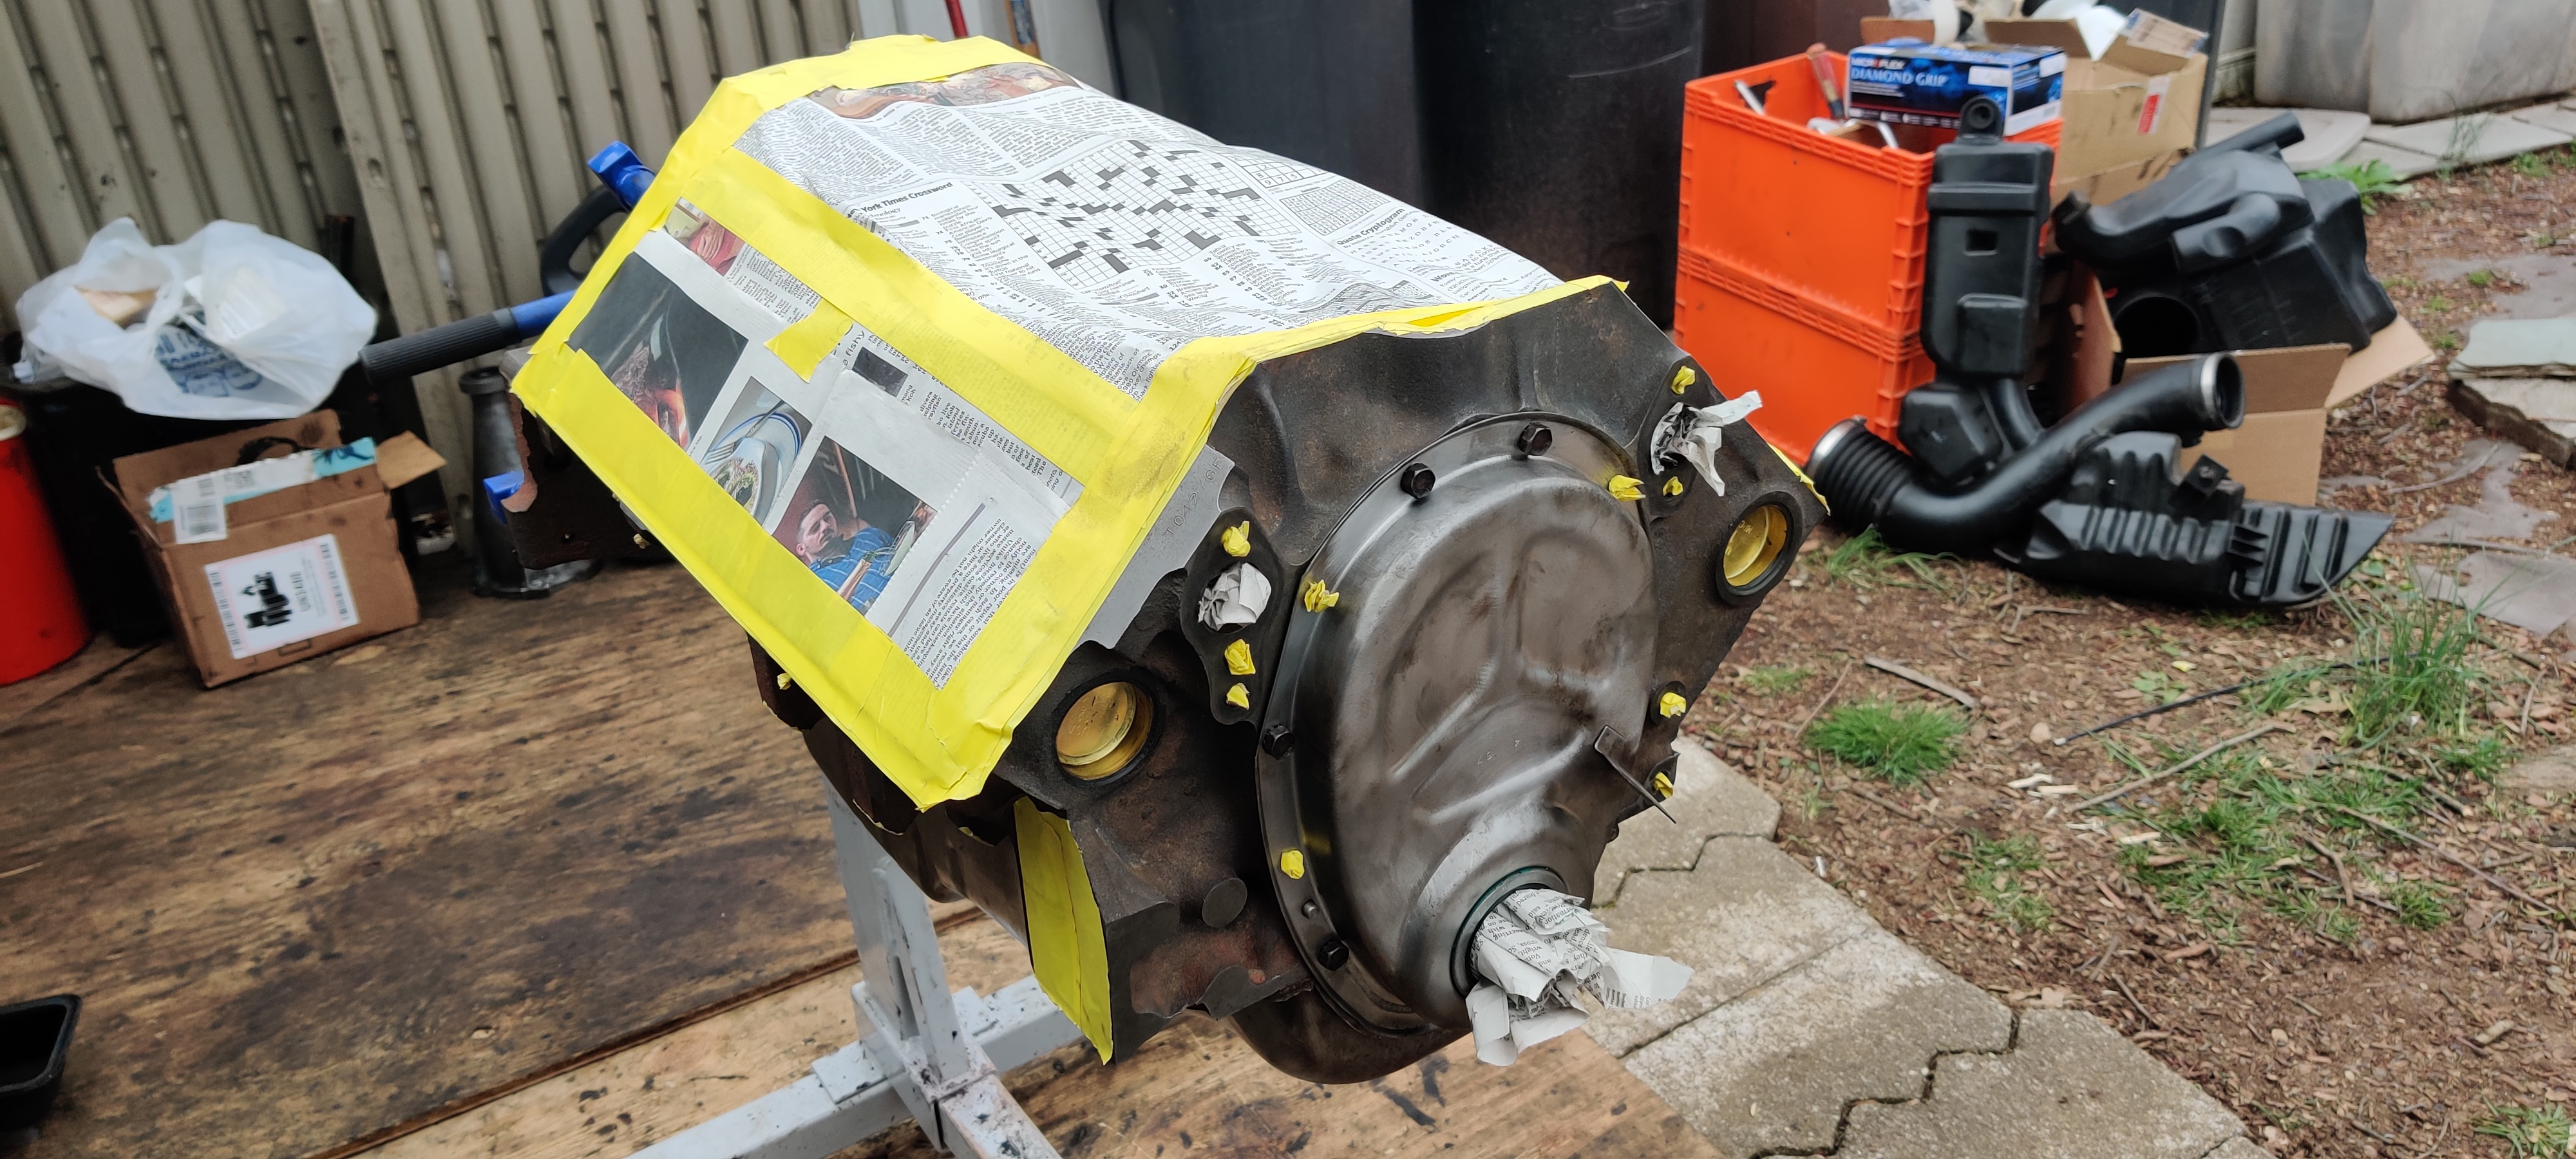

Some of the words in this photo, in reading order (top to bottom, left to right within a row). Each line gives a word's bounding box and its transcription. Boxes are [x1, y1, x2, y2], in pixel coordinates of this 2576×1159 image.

[1850, 68, 1913, 84] DIAMOND
[1915, 72, 1949, 87] GRIP
[860, 202, 882, 213] York
[881, 194, 908, 207] Times
[908, 180, 953, 200] Crossword
[942, 220, 961, 230] puzzle
[949, 223, 976, 235] American
[976, 216, 992, 225] Davis
[964, 225, 981, 234] player
[1336, 233, 1361, 245] Quote
[1360, 207, 1405, 236] Cryptogram
[960, 229, 1005, 247] Comprehension
[984, 234, 999, 243] spot?
[990, 241, 1014, 254] liturgical
[845, 329, 866, 357] fishy
[1094, 353, 1104, 365] the
[1117, 352, 1124, 361] of
[1121, 356, 1134, 375] much
[1132, 348, 1139, 356] of
[1130, 349, 1152, 377] Olympic
[1138, 352, 1161, 372] champs
[1144, 359, 1165, 382] fighters
[905, 388, 916, 401] Koh
[919, 391, 933, 411] divers
[941, 402, 951, 415] live
[945, 405, 956, 419] Koh
[950, 410, 965, 435] ferries
[962, 417, 975, 436] south
[967, 420, 980, 440] abun-
[955, 428, 963, 437] be
[971, 429, 982, 444] now
[987, 429, 994, 438] up
[1005, 441, 1015, 453] but
[1013, 444, 1019, 453] or
[1015, 448, 1025, 462] foot
[1023, 449, 1030, 459] of
[1036, 460, 1046, 475] The
[983, 518, 1001, 538] owner
[984, 522, 1005, 545] cleaner
[1002, 525, 1009, 533] er
[967, 537, 983, 557] might
[989, 533, 1002, 547] who
[996, 529, 1013, 549] nance
[976, 545, 984, 554] or
[977, 547, 990, 563] lives
[994, 539, 1013, 561] Unlike
[1003, 536, 1022, 560] chance
[1010, 540, 1027, 560] notify
[1021, 544, 1031, 556] are
[958, 556, 967, 568] not
[963, 554, 978, 570] have
[974, 549, 997, 576] services
[1002, 560, 1012, 572] the
[1019, 548, 1036, 569] ment)
[951, 569, 959, 578] be
[961, 563, 977, 582] some
[975, 561, 996, 583] hotels,
[998, 558, 1021, 587] missing.
[936, 578, 952, 599] aware
[975, 570, 997, 594] remedy
[984, 572, 1003, 592] owner
[935, 577, 959, 607] property
[941, 582, 963, 610] distance
[960, 584, 976, 605] which
[977, 592, 985, 601] or
[989, 587, 998, 596] In
[992, 585, 1007, 602] poor
[931, 599, 939, 608] of
[965, 595, 975, 607] the
[974, 597, 989, 614] such
[925, 607, 932, 616] an
[940, 599, 958, 622] rentals
[946, 605, 960, 622] have
[954, 601, 978, 630] manager
[975, 602, 993, 625] repair
[913, 617, 927, 636] issue
[929, 611, 942, 629] away
[942, 608, 965, 638] situation.
[967, 624, 975, 633] or
[909, 608, 938, 652] management
[920, 630, 932, 645] and
[930, 623, 940, 636] can
[919, 637, 932, 654] have
[942, 630, 955, 648] right
[947, 639, 956, 649] we
[952, 627, 981, 662] something
[955, 634, 967, 648] that
[929, 648, 943, 666] away
[946, 650, 956, 661] the
[940, 664, 953, 681] (like
[1516, 892, 1535, 906] feared
[1528, 905, 1540, 918] said
[1488, 925, 1505, 935] with
[1517, 944, 1542, 956] wright,
[1573, 950, 1587, 961] they
[1538, 958, 1551, 968] and
